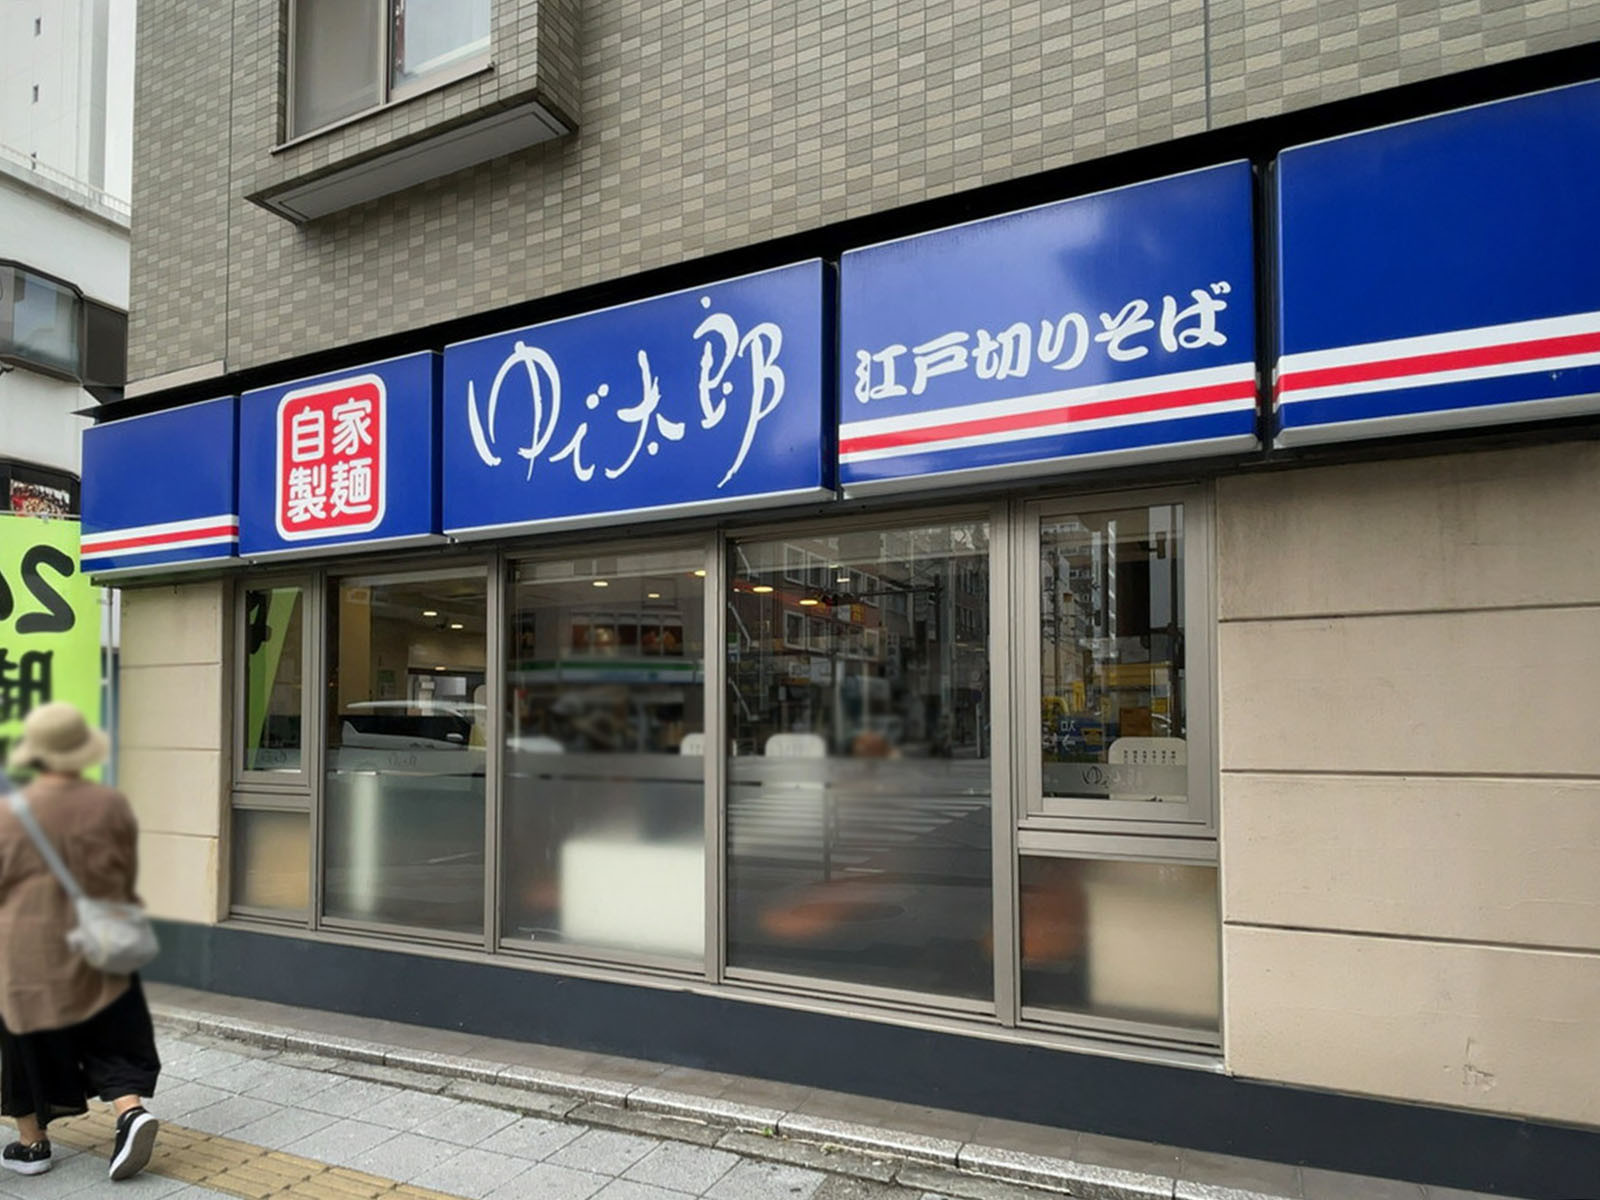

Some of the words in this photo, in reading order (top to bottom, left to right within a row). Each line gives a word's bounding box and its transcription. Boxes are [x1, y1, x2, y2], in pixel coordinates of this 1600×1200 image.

[854, 281, 1231, 404] 江戸切りそば
[291, 397, 373, 463] 自家
[468, 296, 786, 488] ゆで太郎
[287, 457, 373, 523] 製麺
